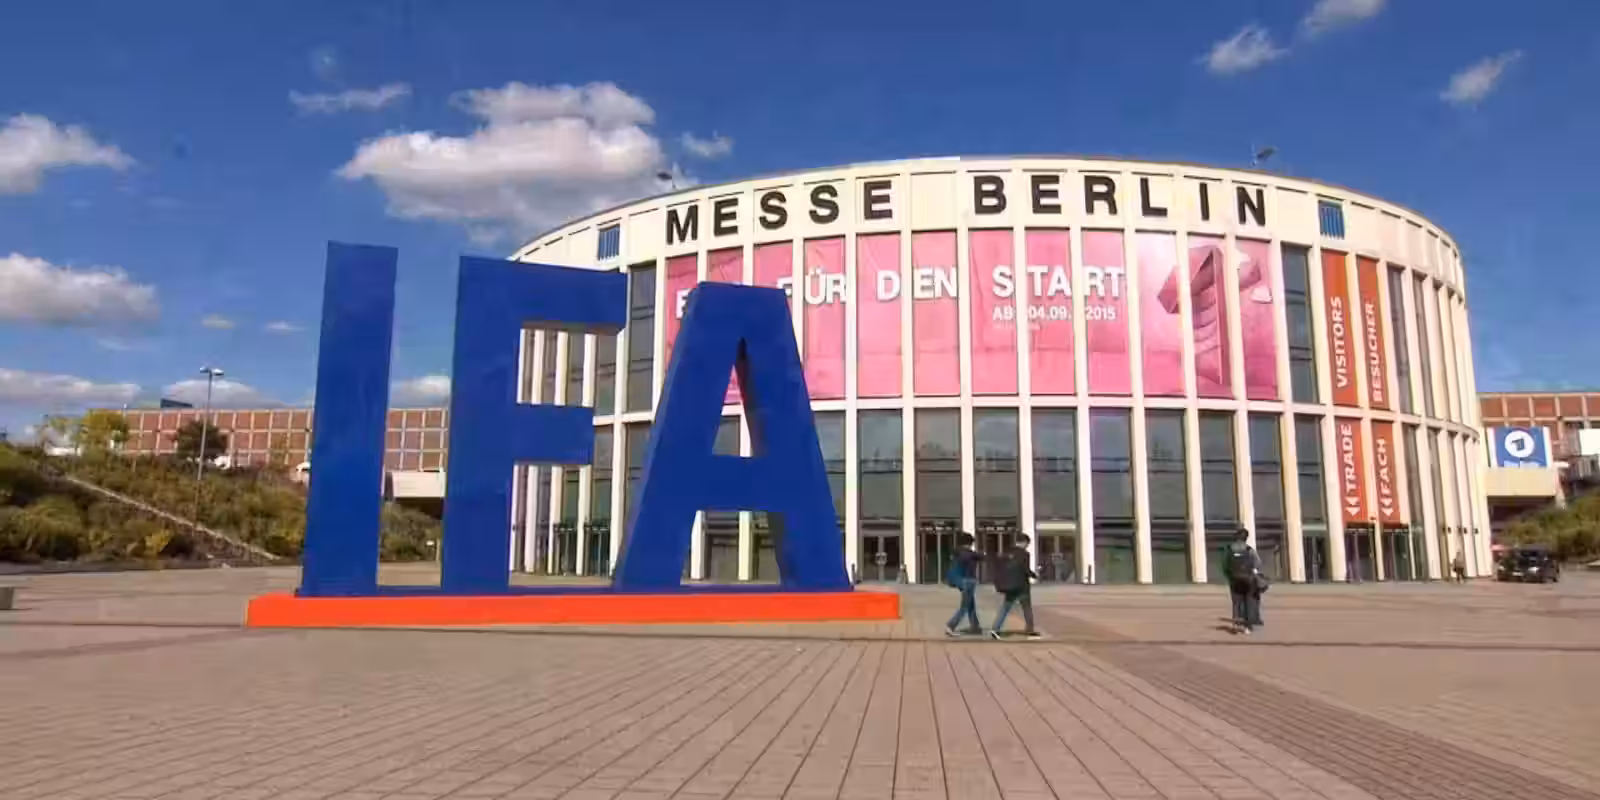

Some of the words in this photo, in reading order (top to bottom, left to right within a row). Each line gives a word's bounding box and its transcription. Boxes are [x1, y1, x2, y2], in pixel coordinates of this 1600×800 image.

[666, 180, 893, 245] MESSE
[973, 175, 1266, 227] BERLIN
[876, 266, 957, 301] DEN
[992, 264, 1125, 298] START
[992, 305, 1013, 321] AB
[1331, 296, 1348, 388] VISITORS
[1365, 302, 1383, 402] BESUCHER
[301, 240, 855, 597] IFA
[1341, 423, 1357, 493] TRADE
[1376, 438, 1391, 495] FACH
